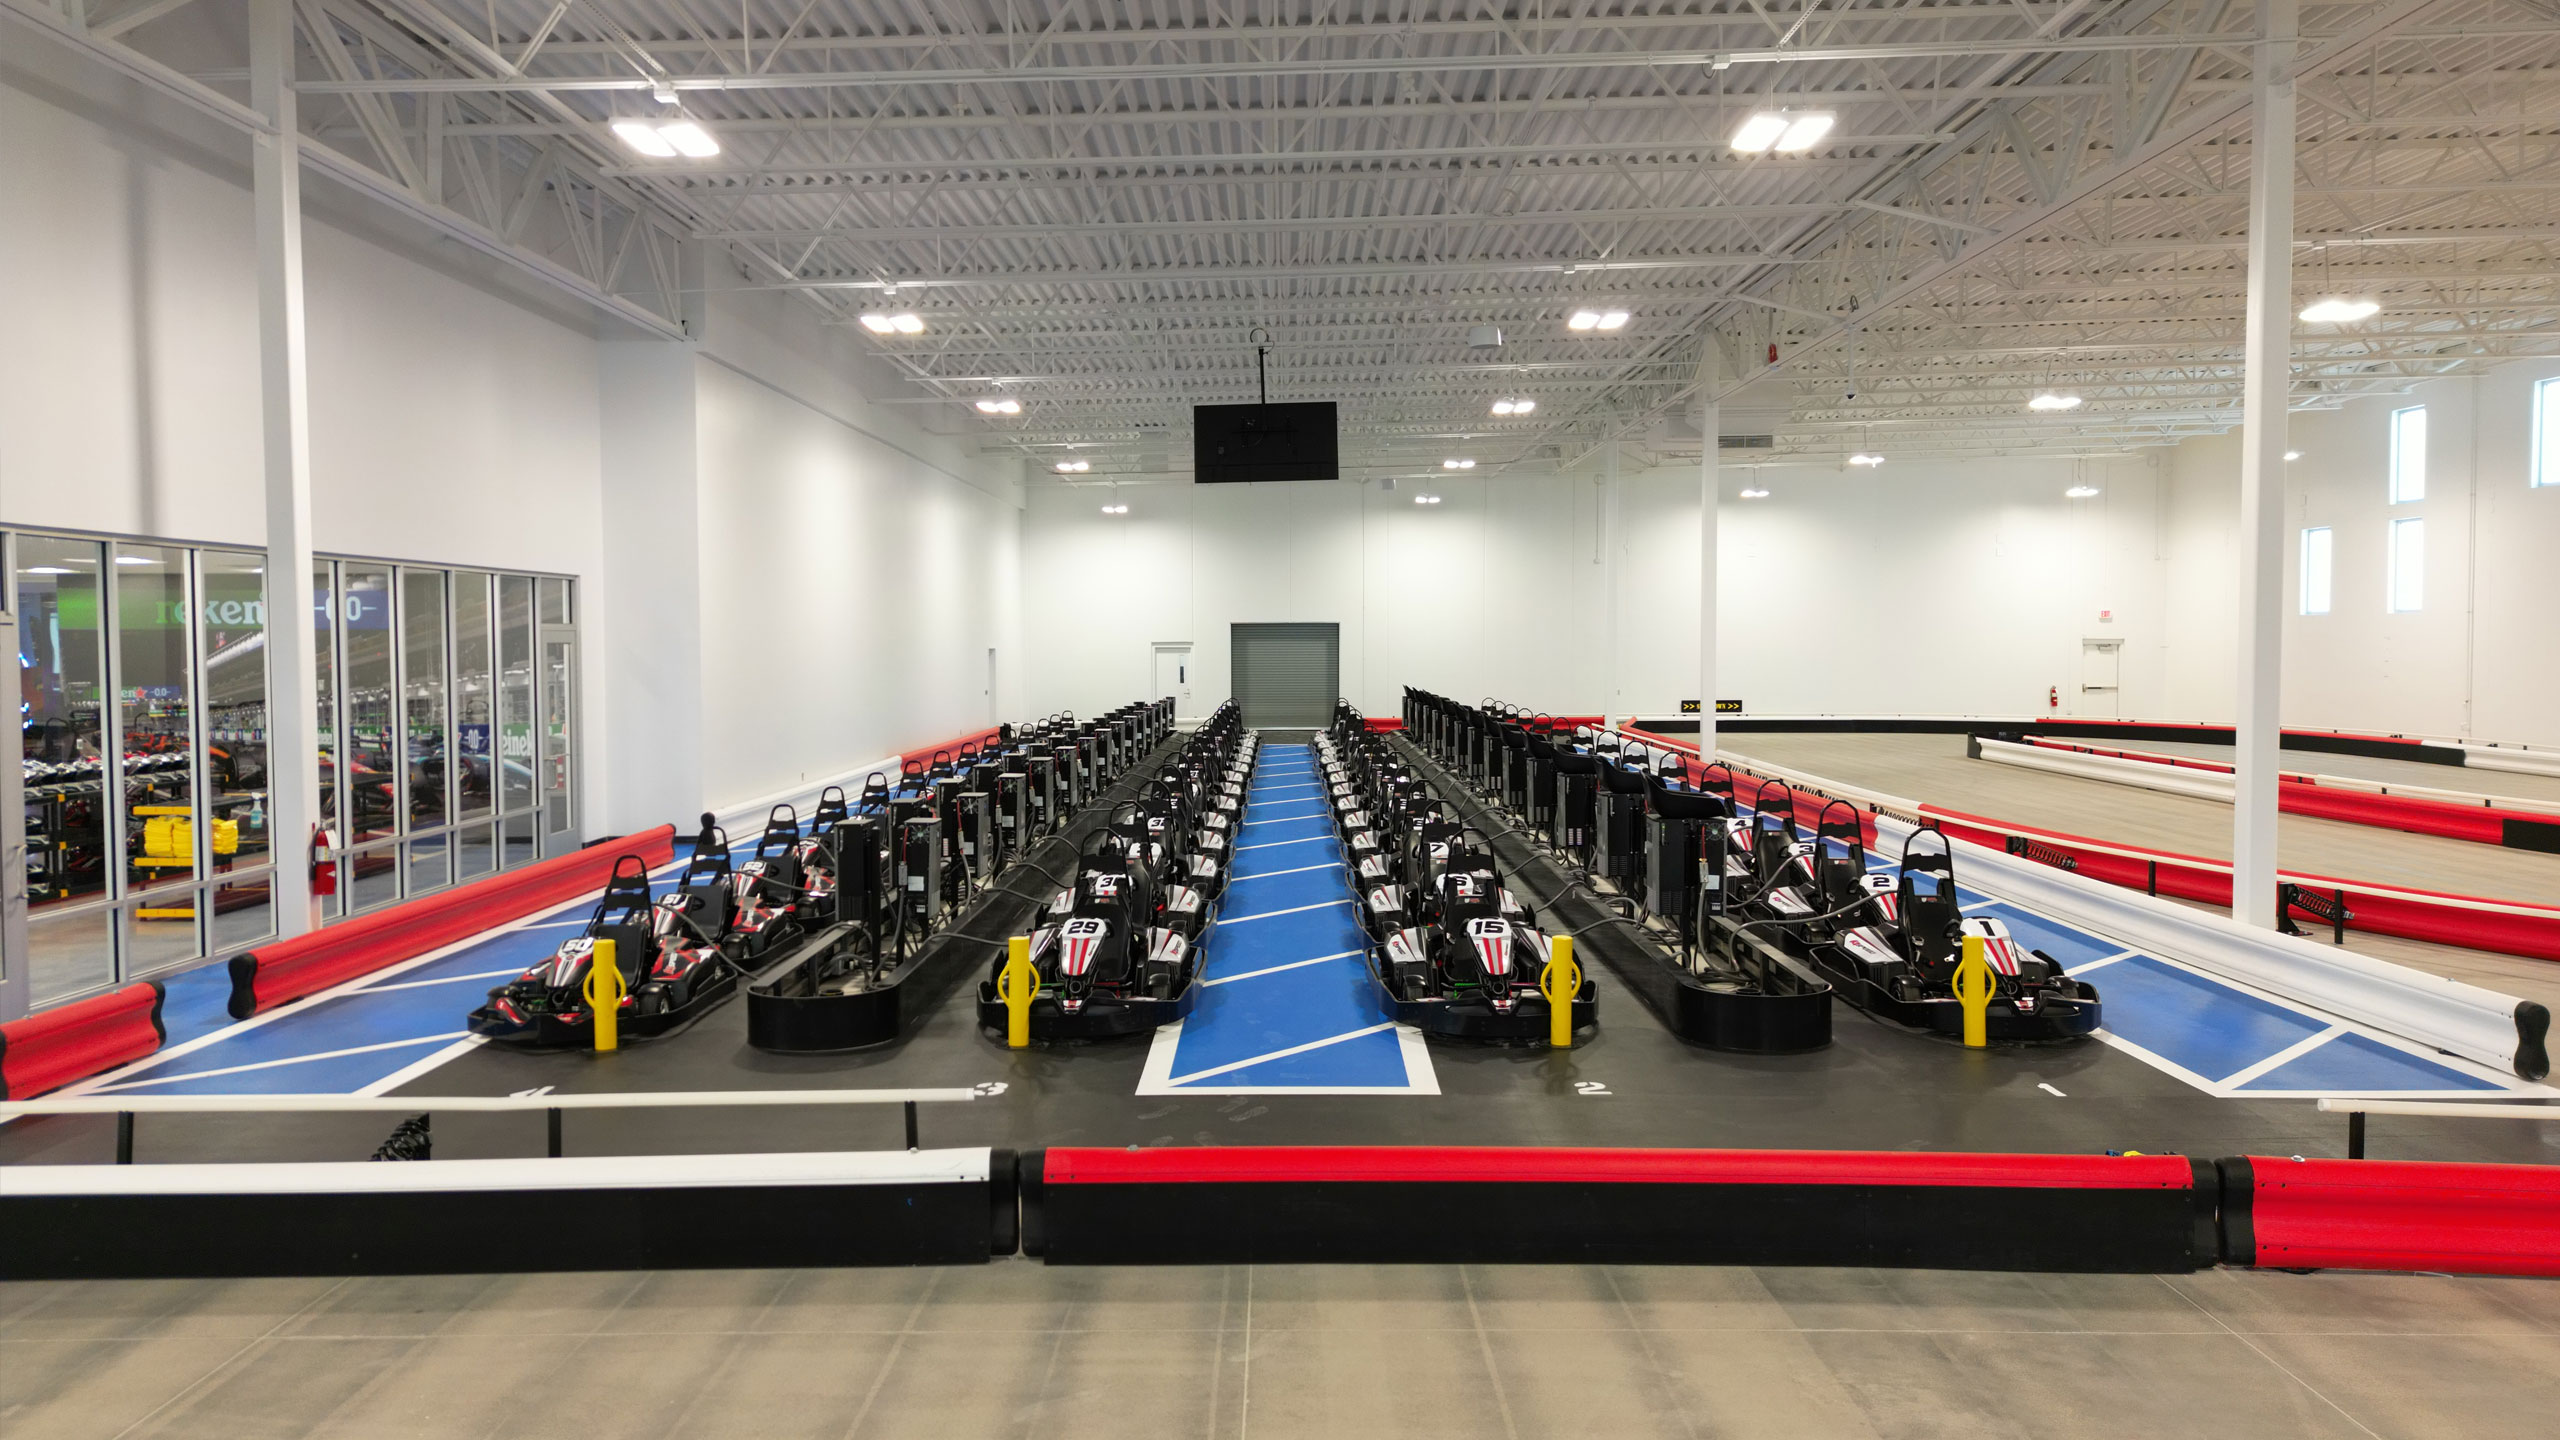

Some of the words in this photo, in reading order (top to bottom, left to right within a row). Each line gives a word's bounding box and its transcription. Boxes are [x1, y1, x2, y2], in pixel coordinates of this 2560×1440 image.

[1735, 819, 1747, 827] 4
[1872, 877, 1890, 888] 2
[1068, 921, 1100, 934] 29
[1475, 921, 1504, 934] 15
[1979, 921, 1996, 936] 1
[974, 1081, 1009, 1096] 3
[1574, 1081, 1613, 1095] 2
[2037, 1082, 2067, 1097] 1
